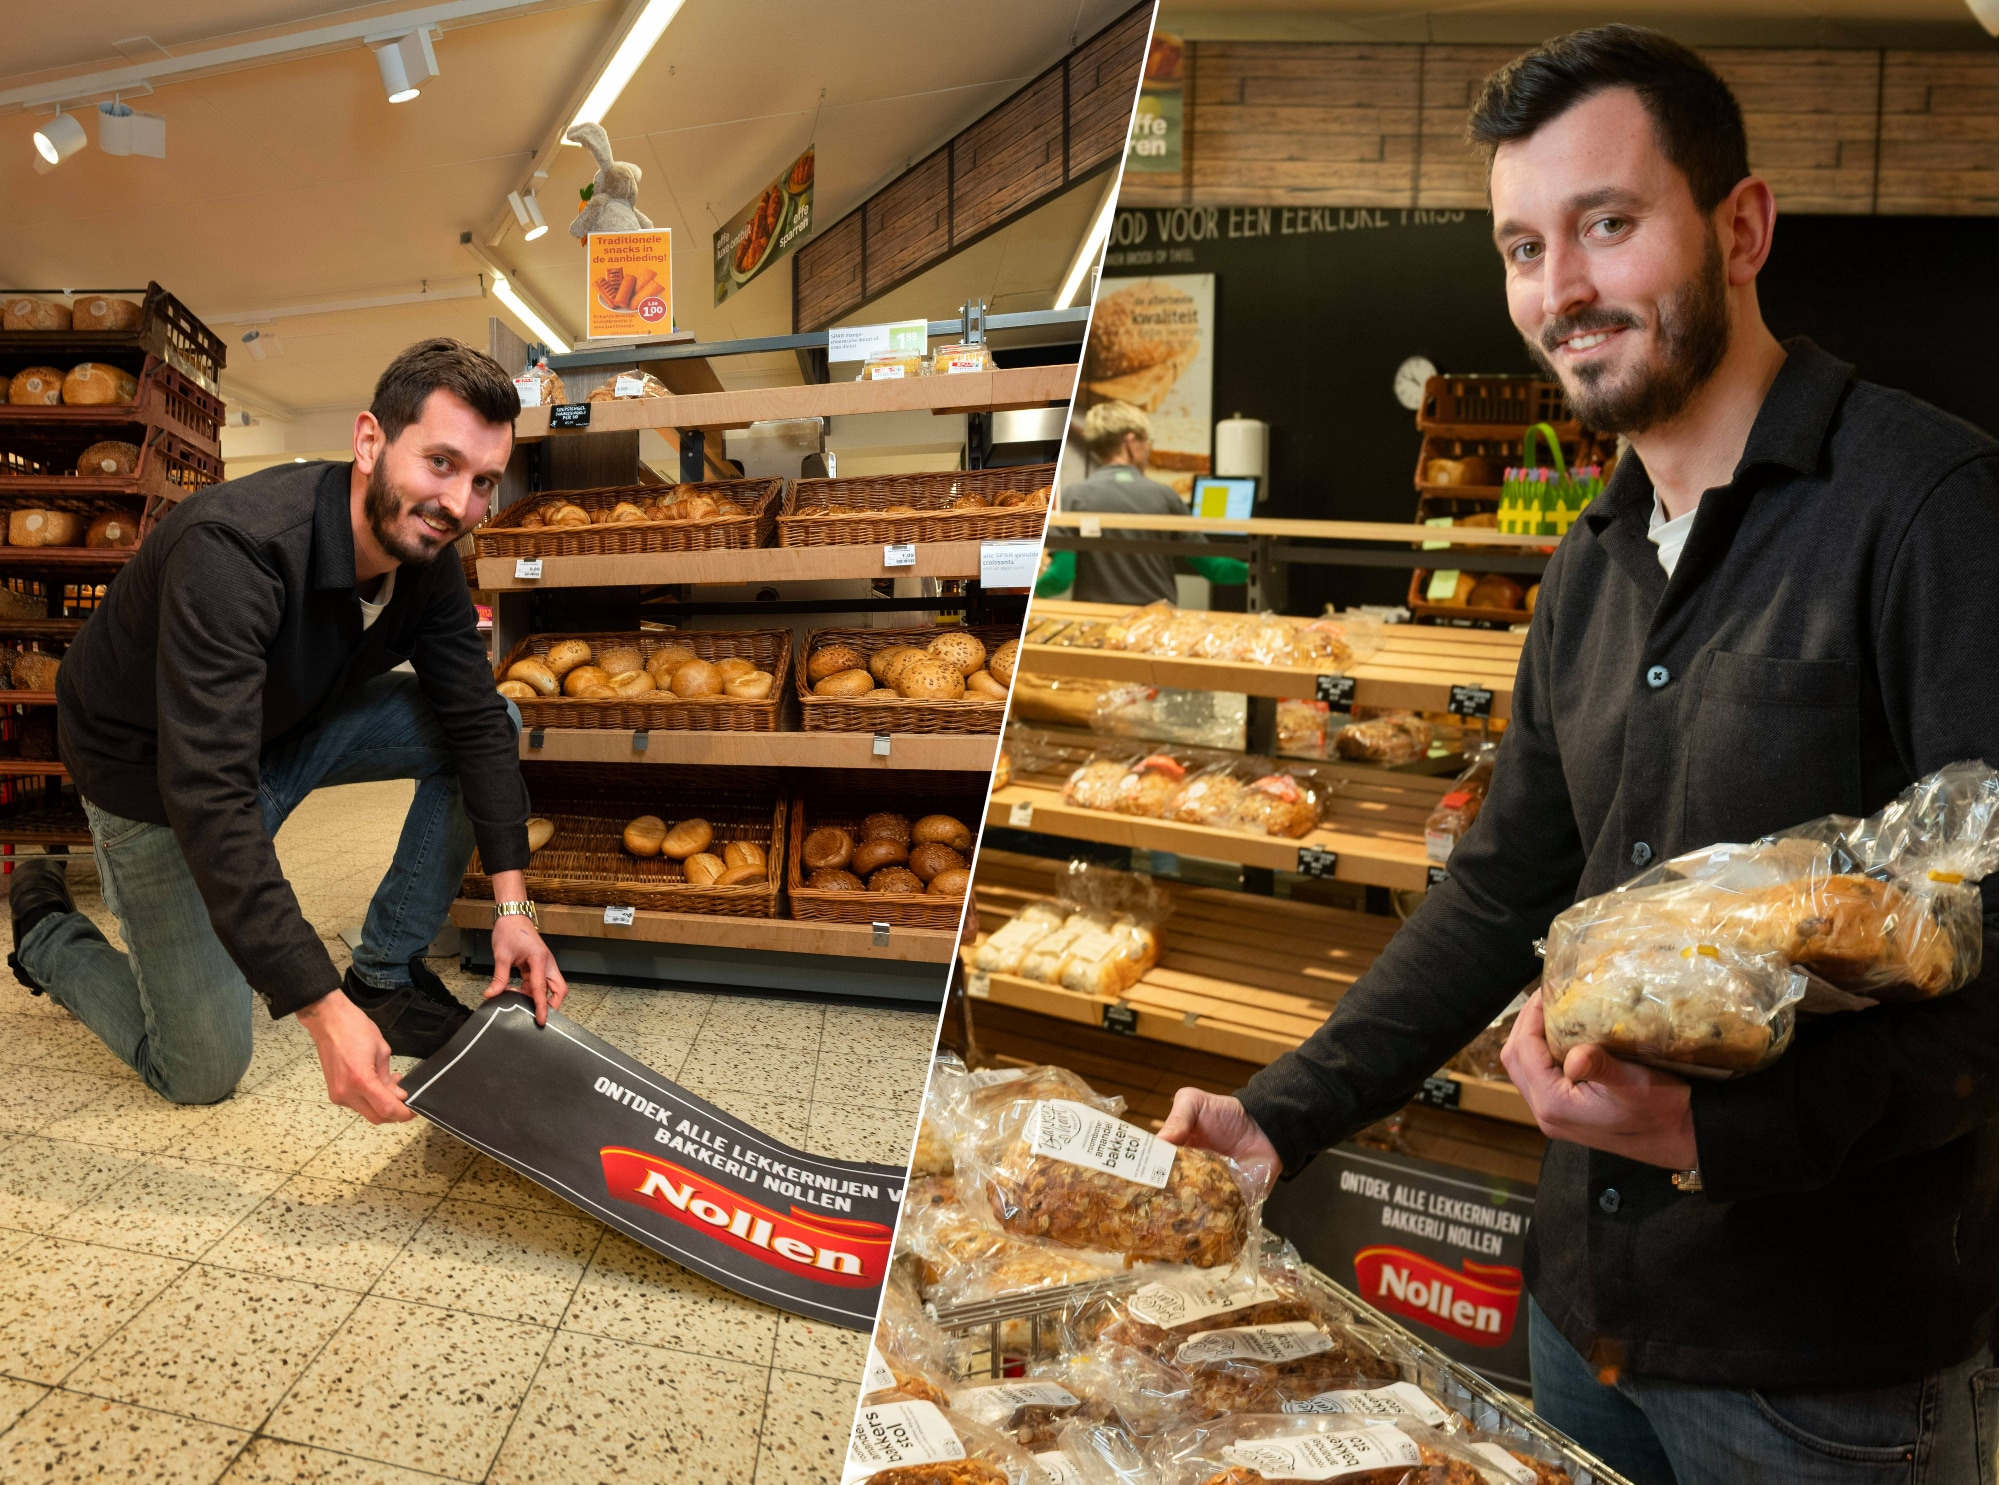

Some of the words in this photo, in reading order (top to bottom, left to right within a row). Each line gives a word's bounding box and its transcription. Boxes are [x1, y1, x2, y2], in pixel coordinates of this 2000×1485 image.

[793, 204, 809, 224] effe
[1156, 207, 1219, 242] VOOR
[1228, 207, 1271, 238] EEN
[596, 235, 661, 245] Traditionele
[603, 245, 640, 254] snacks
[643, 245, 653, 253] in
[717, 232, 730, 249] effe
[717, 244, 730, 260] luxe
[730, 224, 751, 249] ontbijt
[779, 217, 809, 248] sparren
[592, 255, 605, 263] de
[607, 253, 667, 263] aanbieding!
[643, 306, 663, 317] 1.00
[1131, 309, 1198, 325] kwaliteit
[593, 1076, 673, 1127] ONTDEK
[674, 1119, 729, 1151] ALLE
[732, 1145, 879, 1200] LEKKERNIJEN
[1087, 1120, 1102, 1154] roomboter
[1095, 1121, 1113, 1158] amandel
[1101, 1122, 1129, 1168] bakkers
[1124, 1135, 1141, 1160] stol
[654, 1127, 758, 1183] BAKKERIJ
[763, 1175, 852, 1213] NOLLEN
[1340, 1170, 1391, 1202] ONTDEK
[1393, 1184, 1428, 1214] ALLE
[1428, 1193, 1522, 1235] LEKKERNIJEN
[635, 1168, 871, 1278] Nollen
[1381, 1206, 1446, 1241] BAKKERIJ
[1447, 1224, 1503, 1257] NOLLEN
[1378, 1263, 1503, 1334] Nollen
[866, 1411, 903, 1463] bakkers
[886, 1422, 914, 1449] stol
[1343, 1435, 1371, 1452] stol
